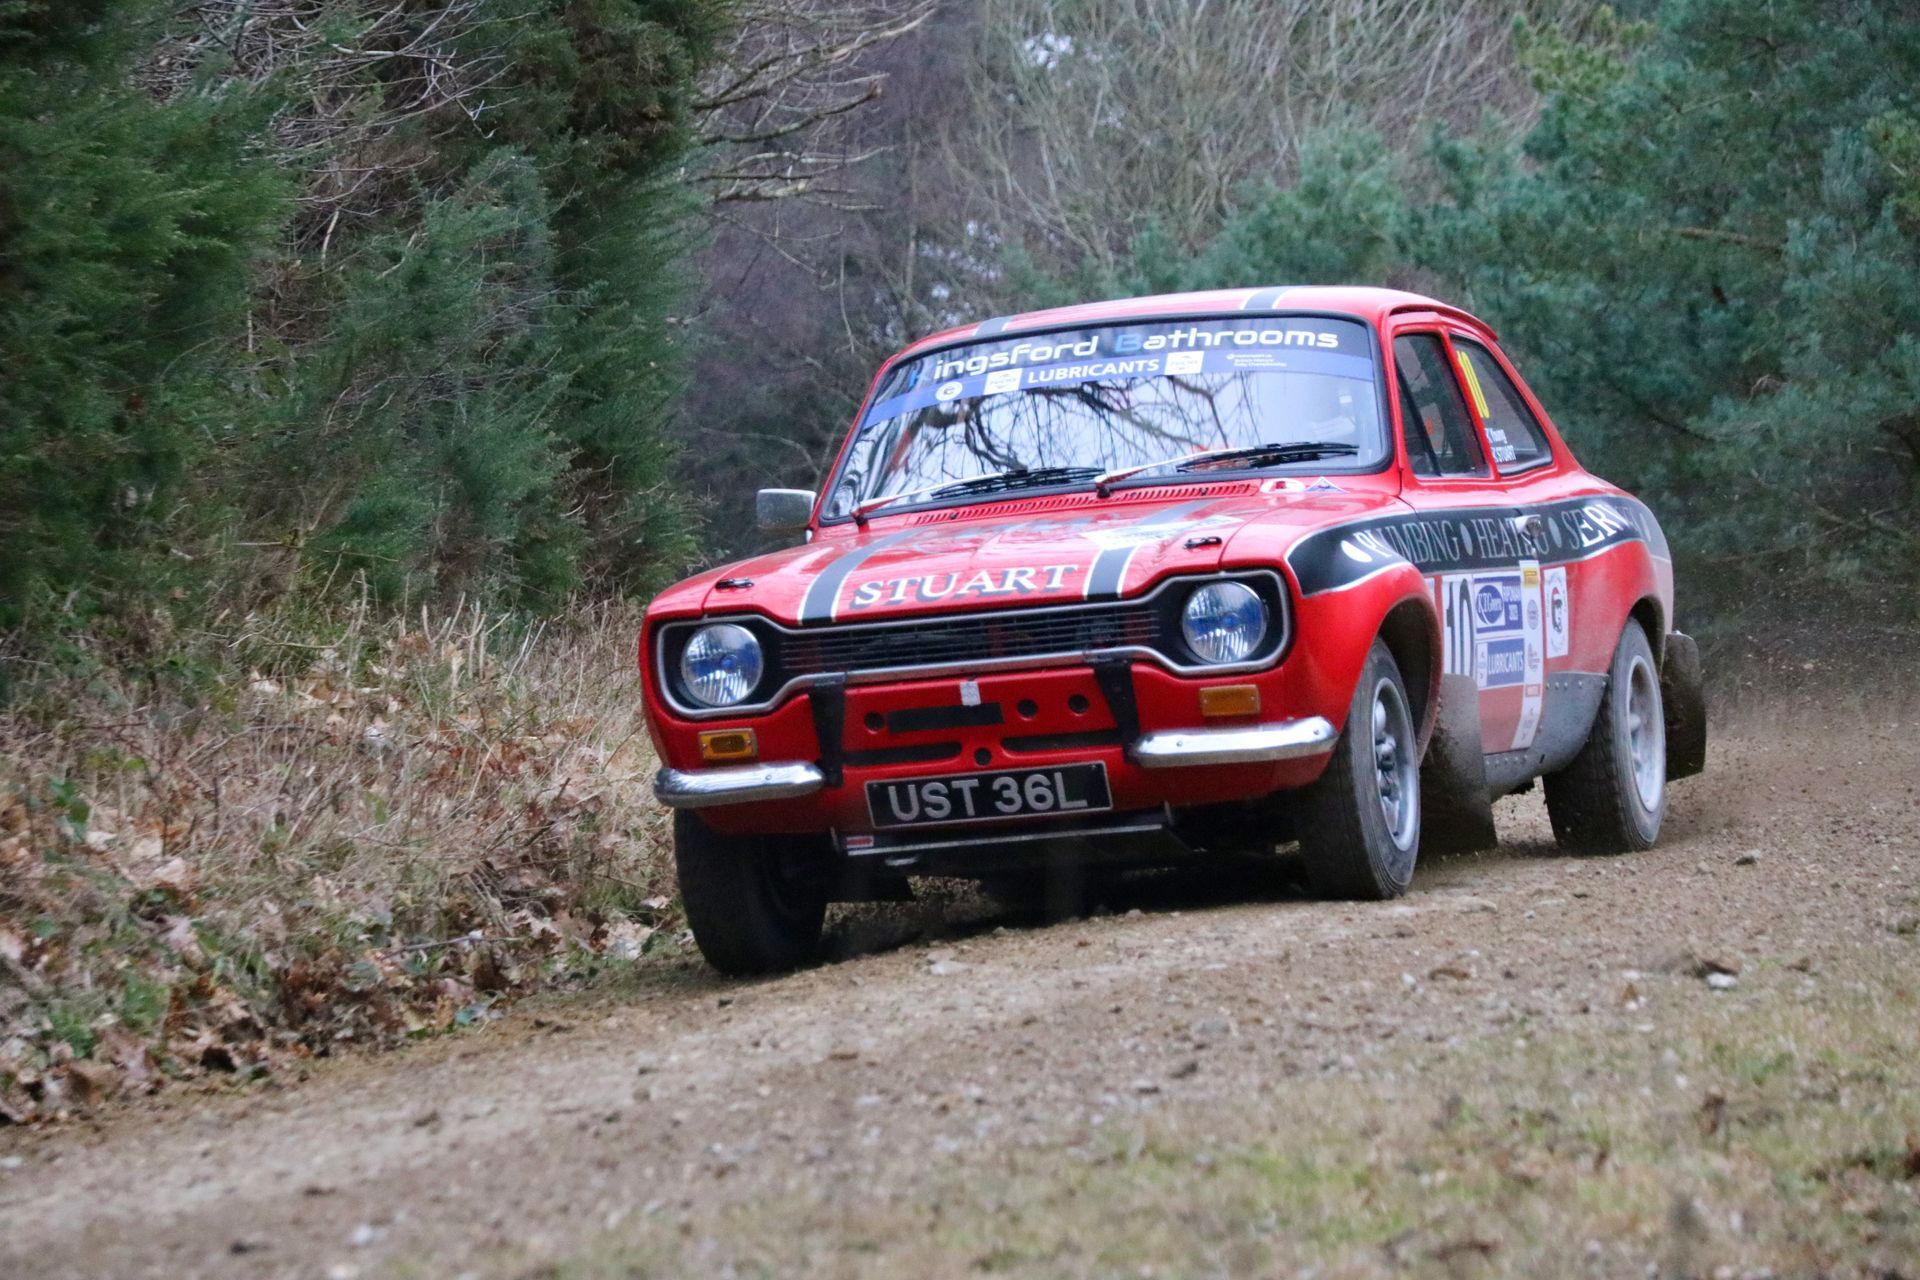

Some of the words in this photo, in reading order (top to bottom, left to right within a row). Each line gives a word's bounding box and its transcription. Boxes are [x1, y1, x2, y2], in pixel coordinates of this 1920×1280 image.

[1114, 327, 1339, 352] Bathrooms
[1027, 359, 1160, 384] LUBRICANTS
[1470, 518, 1550, 558] HEATG
[852, 564, 1079, 608] STUART
[1446, 578, 1474, 676] 10
[1488, 651, 1524, 675] LUBRICANTS
[887, 778, 980, 822] UST
[991, 771, 1088, 814] 36L
